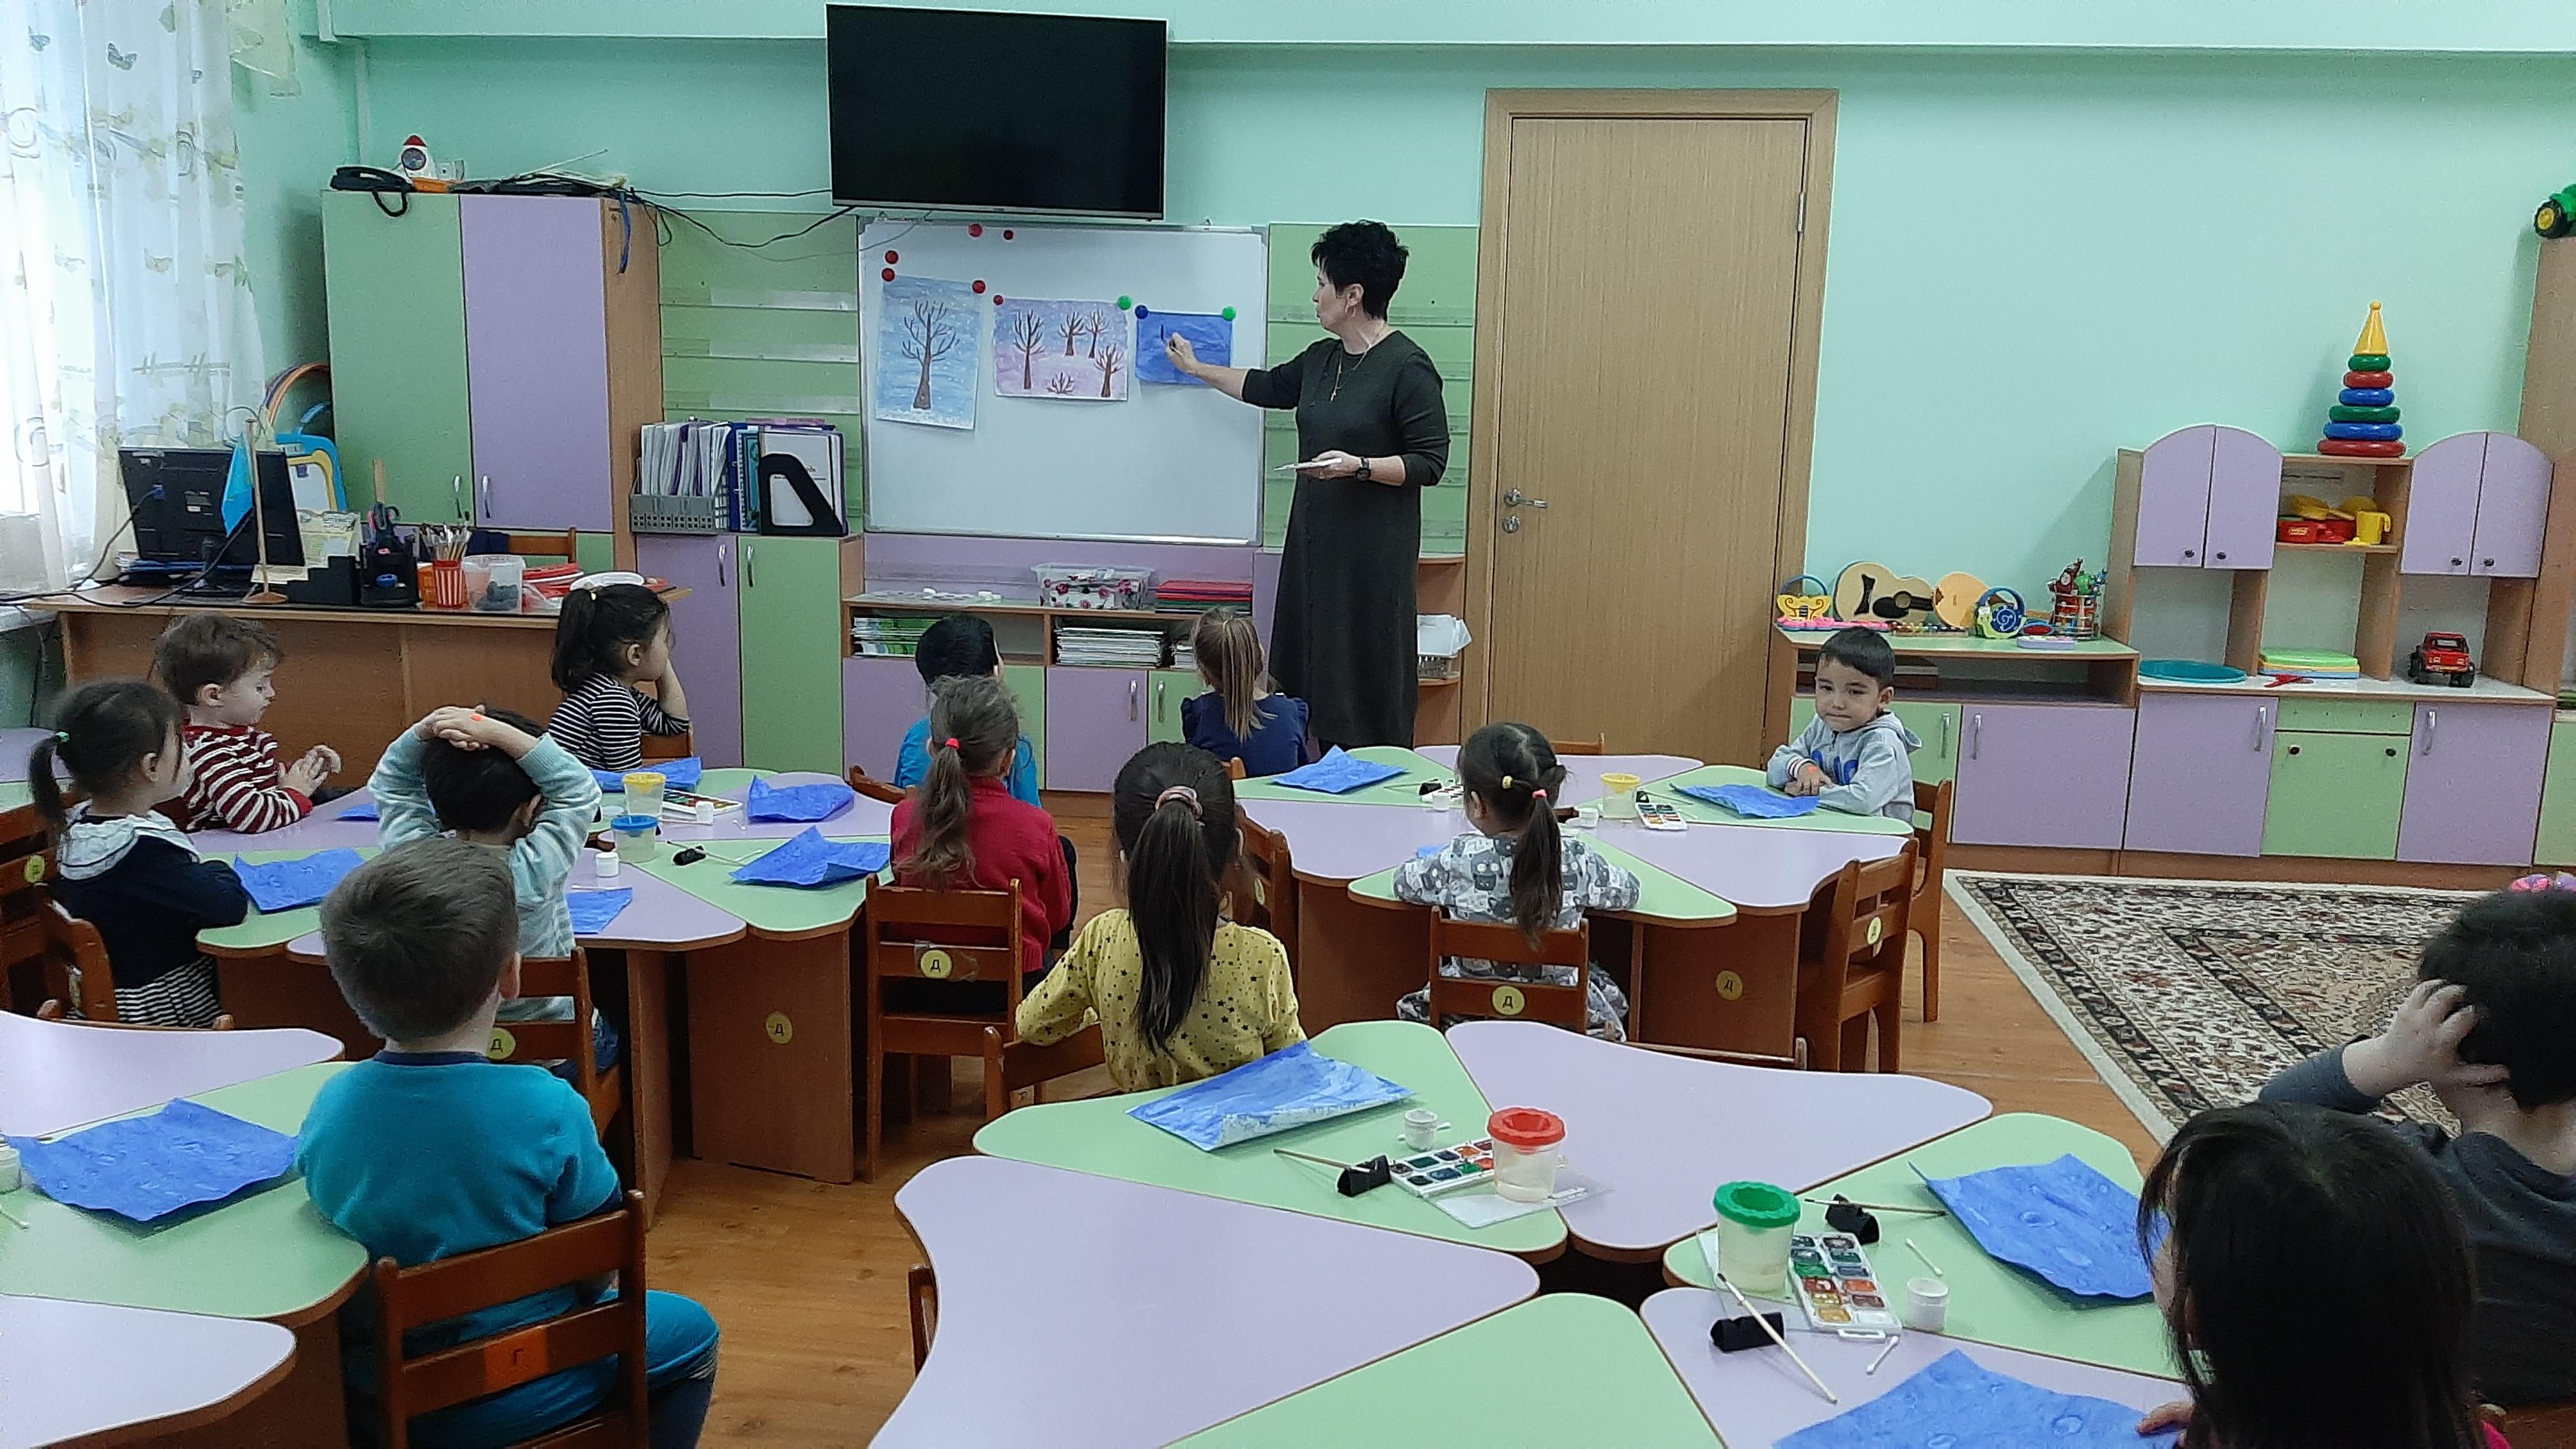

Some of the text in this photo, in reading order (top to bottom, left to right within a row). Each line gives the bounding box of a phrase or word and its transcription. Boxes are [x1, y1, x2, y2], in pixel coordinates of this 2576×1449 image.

[930, 959, 941, 972] Д
[1502, 995, 1514, 1009] Д
[772, 1023, 784, 1037] Д
[490, 1038, 503, 1053] Д
[513, 1348, 524, 1365] Г
